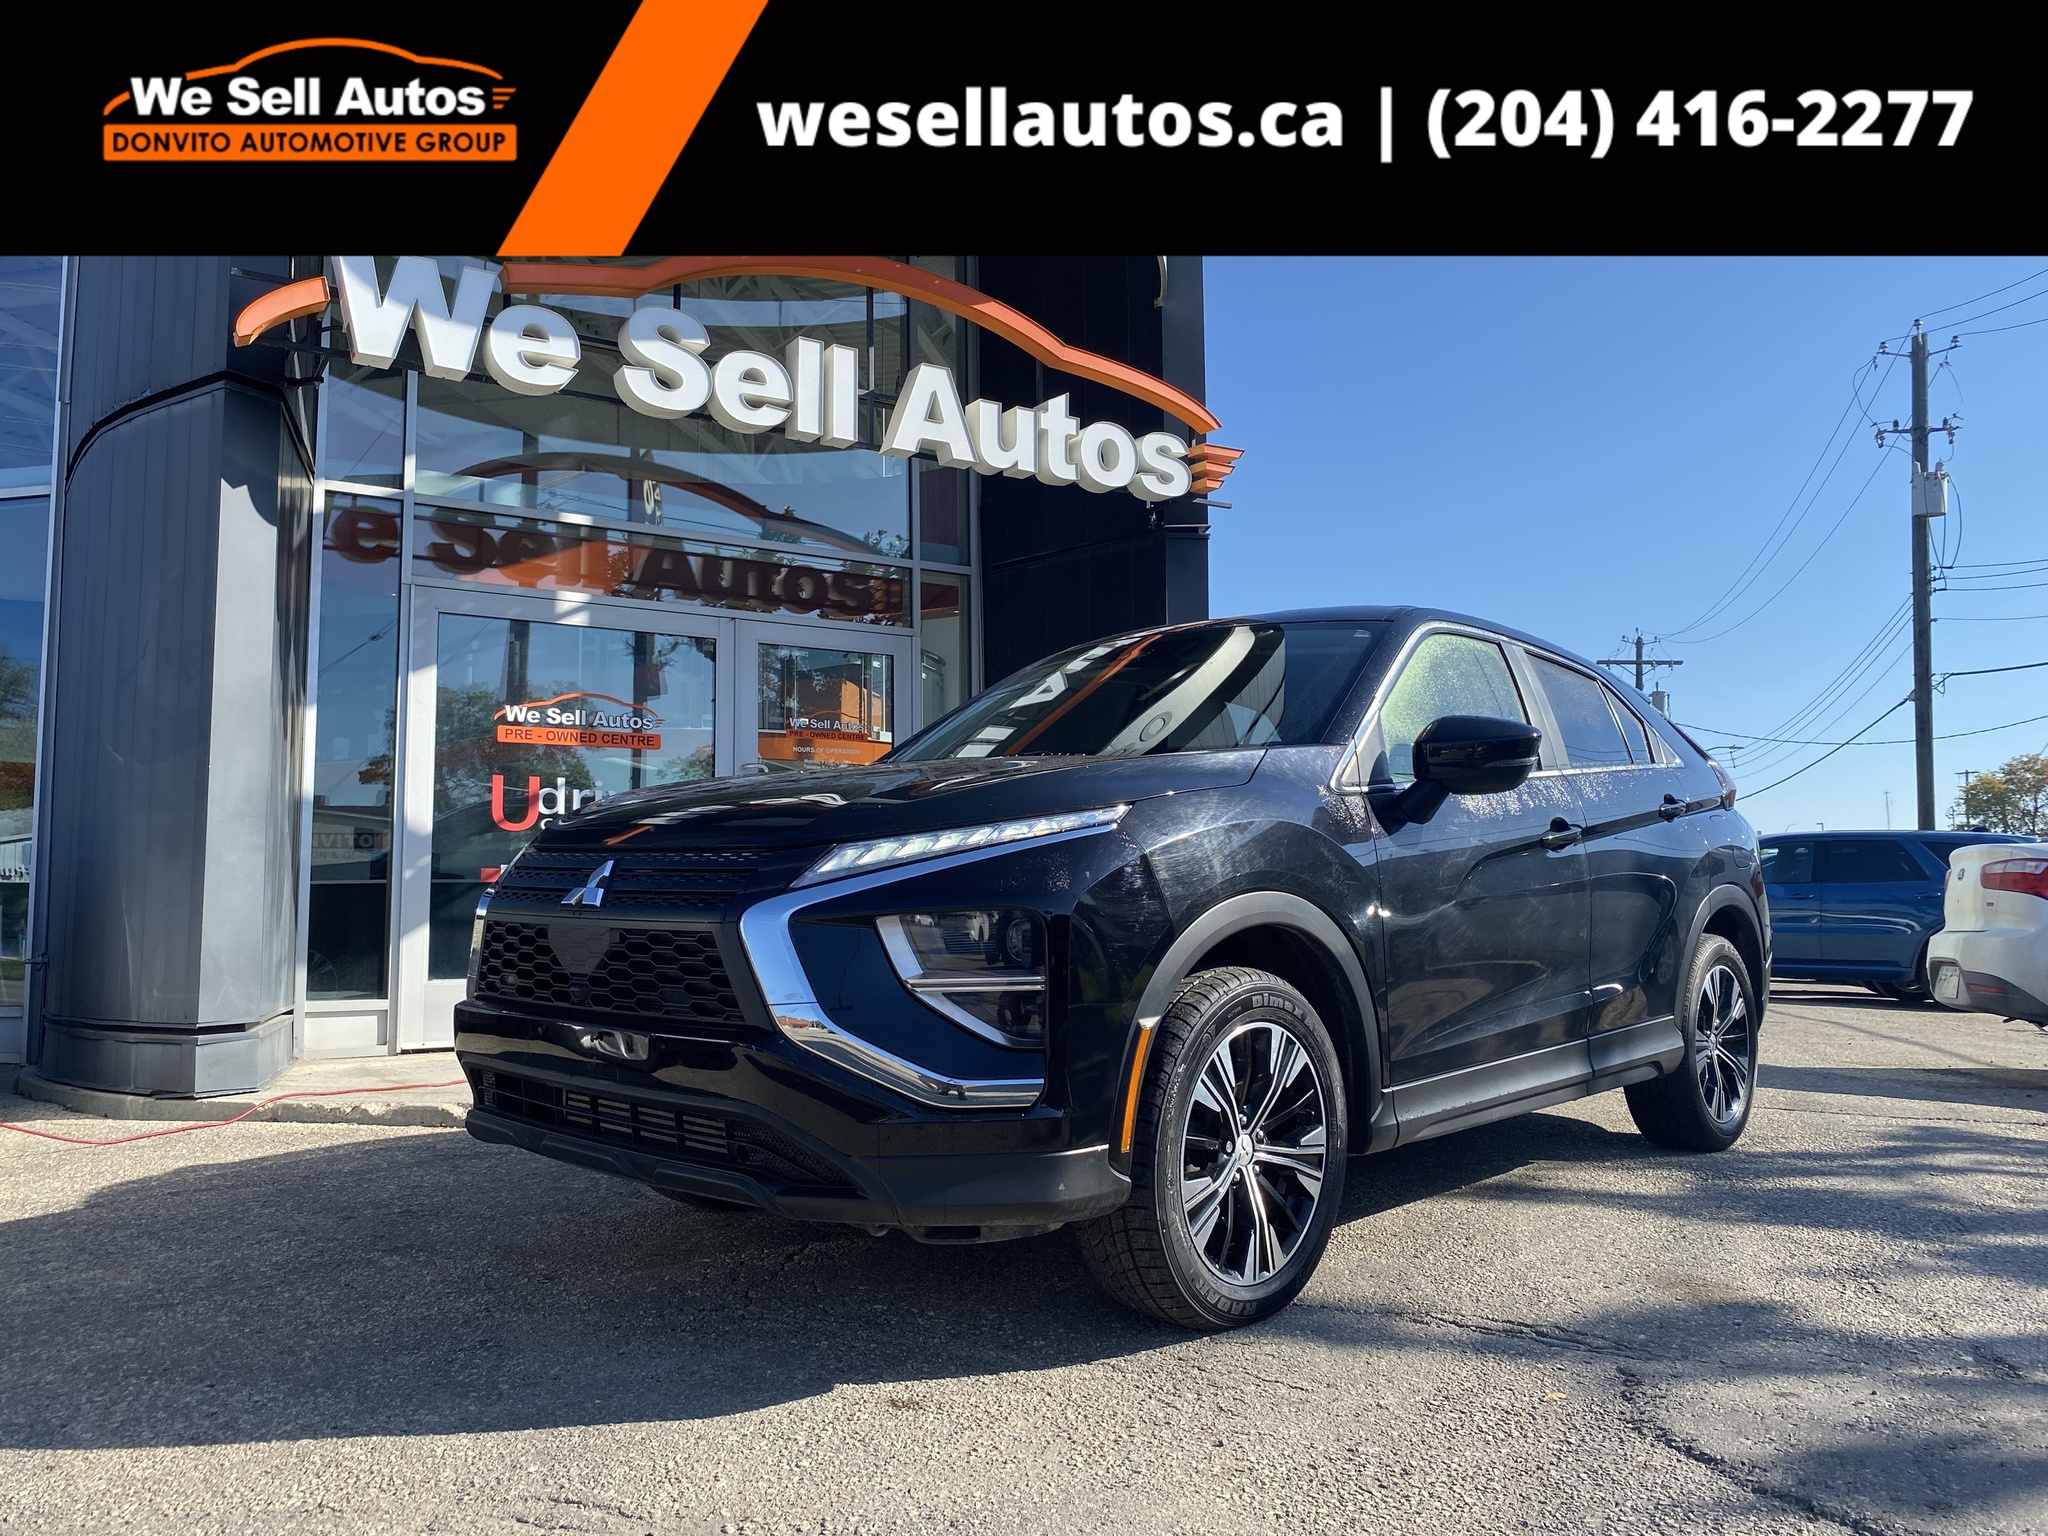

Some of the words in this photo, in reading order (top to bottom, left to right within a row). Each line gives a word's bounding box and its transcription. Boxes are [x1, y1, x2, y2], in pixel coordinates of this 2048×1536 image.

[330, 256, 581, 396] We
[613, 306, 859, 448] Sell
[879, 362, 1193, 501] Autos
[504, 704, 541, 724] We
[547, 707, 587, 726] Sell
[592, 711, 655, 730] Autos
[789, 717, 809, 729] We
[810, 719, 831, 730] Sell
[833, 720, 864, 731] Autos
[504, 728, 533, 740] PRE
[545, 730, 598, 744] OWNED
[601, 733, 655, 747] CENTRE
[810, 731, 836, 739] OWNED
[837, 732, 865, 741] CENTRE
[491, 774, 617, 832] Udri
